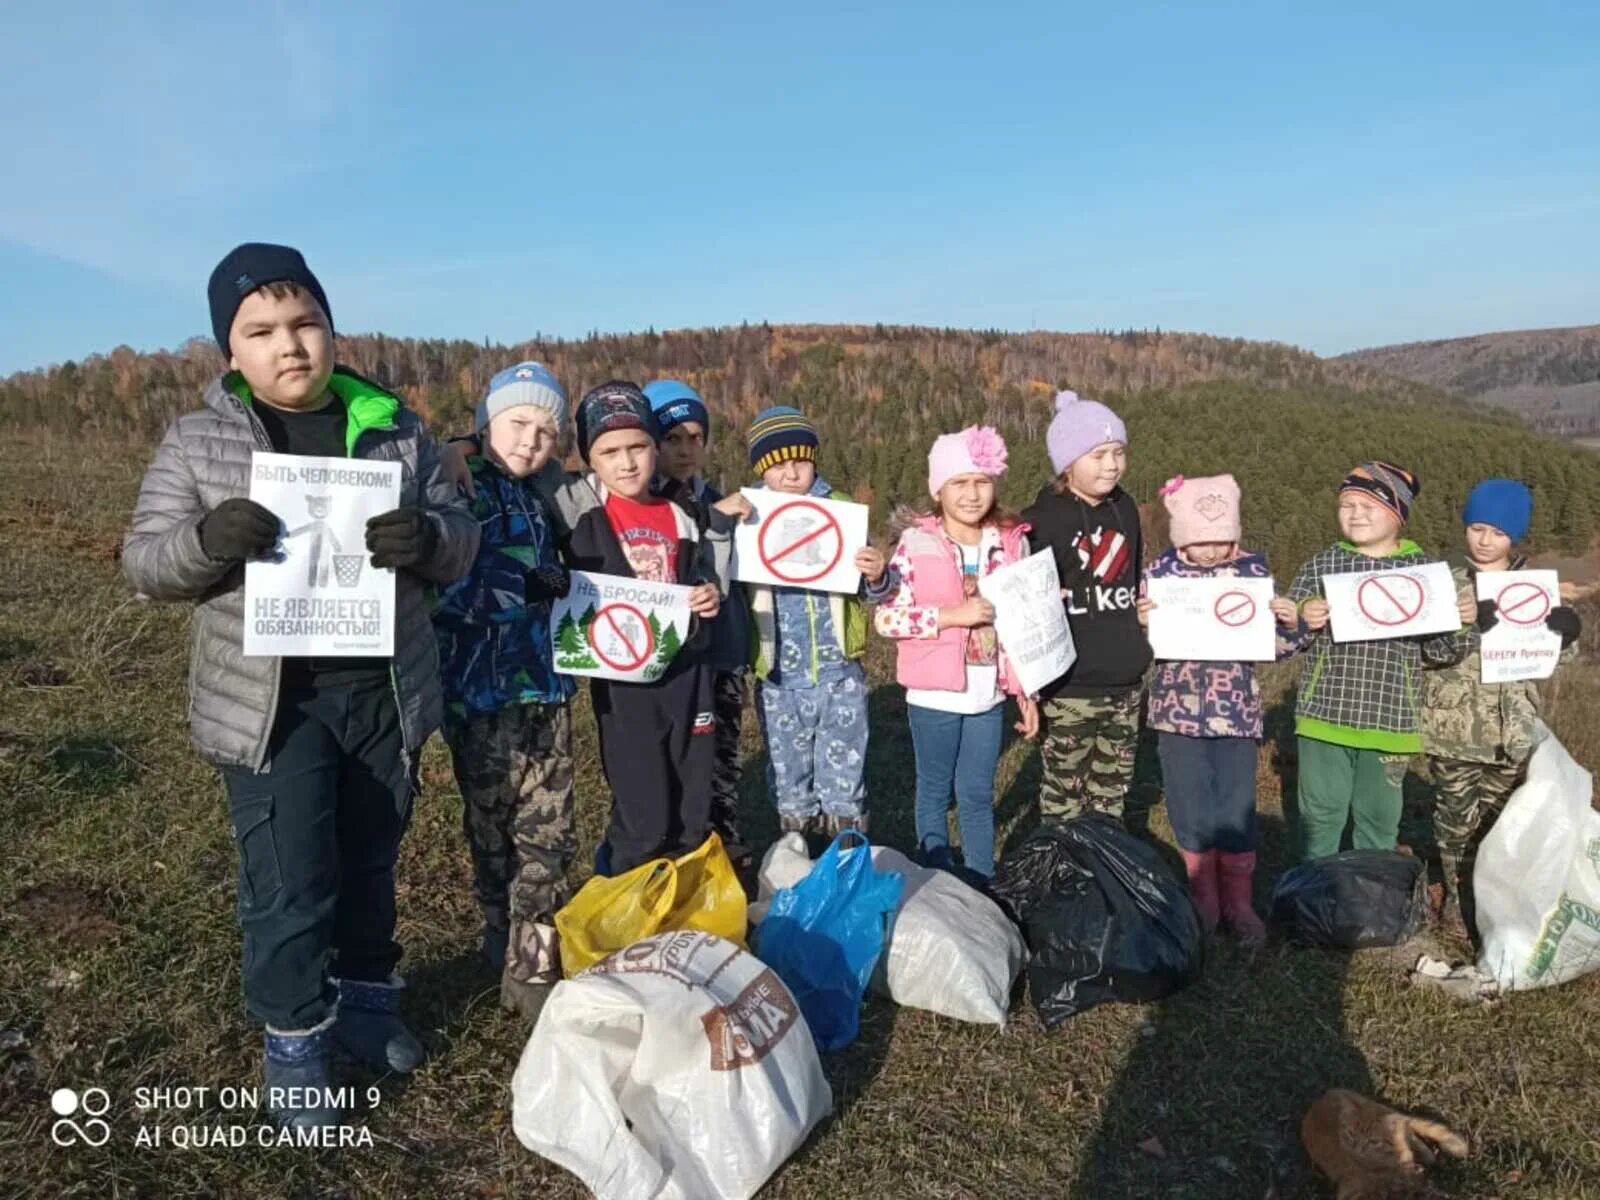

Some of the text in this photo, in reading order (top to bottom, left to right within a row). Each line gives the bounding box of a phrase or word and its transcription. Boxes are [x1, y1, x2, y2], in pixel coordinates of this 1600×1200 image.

[255, 464, 392, 488] БЫТЬ ЧЕЛОВЕКОМ!
[576, 583, 675, 606] НЕ БРОСАЙ!
[255, 597, 381, 619] НЕ ЯВЛЯЕТСЯ
[255, 620, 381, 636] ОБЯЗАННОСТЬЮ!
